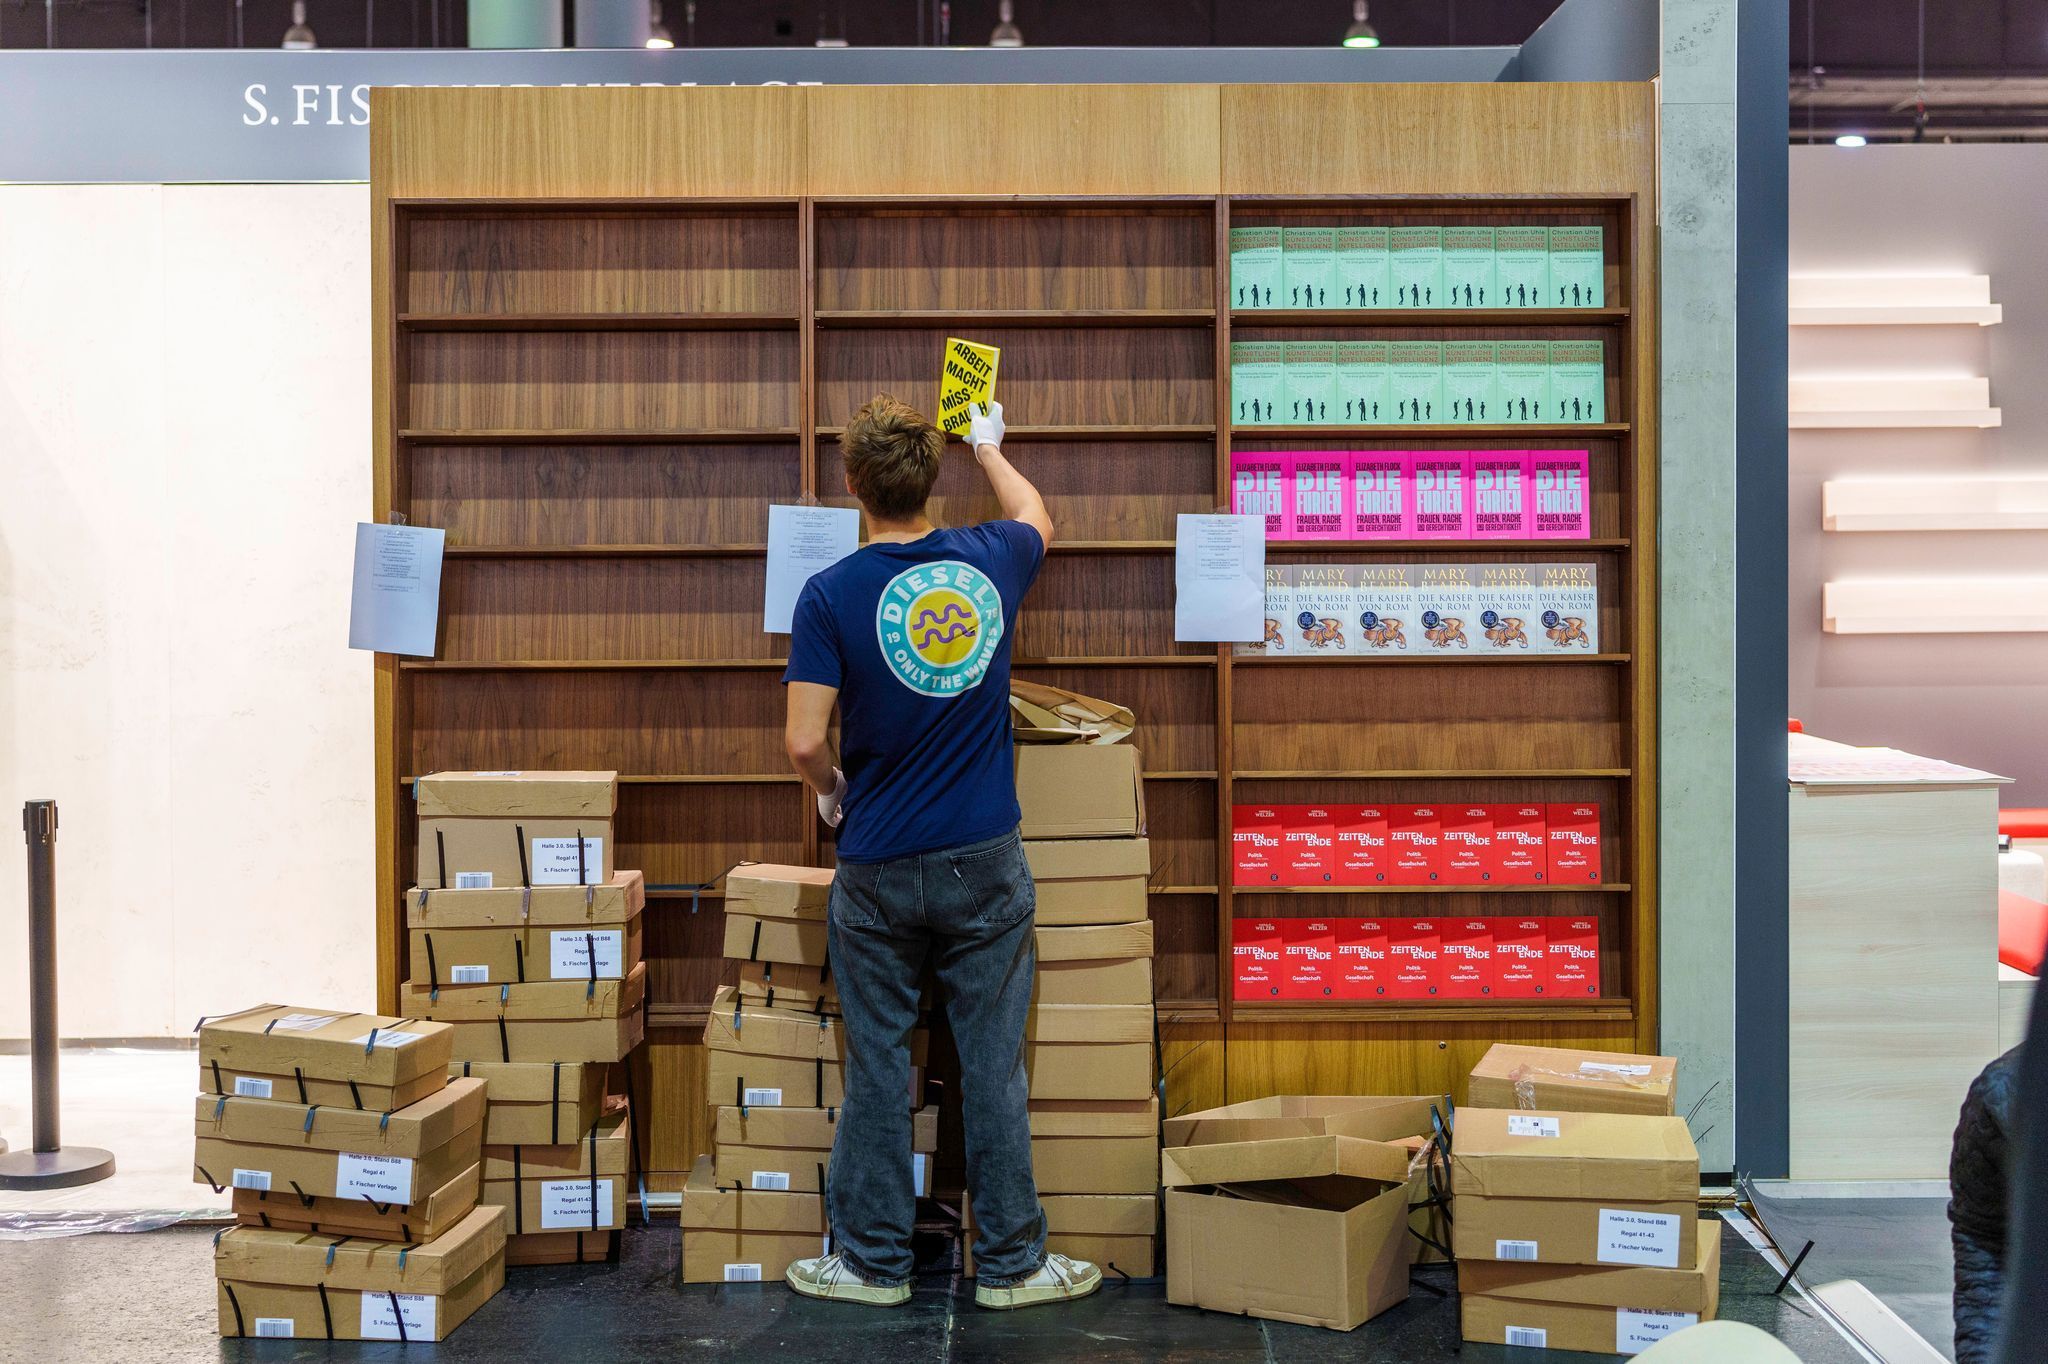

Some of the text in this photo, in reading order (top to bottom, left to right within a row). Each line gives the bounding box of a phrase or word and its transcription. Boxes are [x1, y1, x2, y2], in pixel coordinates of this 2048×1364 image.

[242, 83, 280, 126] S.
[953, 342, 993, 378] ARBEIT
[946, 360, 988, 393] MACHT
[942, 401, 988, 433] BRAUH
[1296, 463, 1341, 471] ELIZABETH FLOCK
[1236, 472, 1282, 491] DIE
[1296, 471, 1341, 491] DIE
[1356, 471, 1401, 490] DIE
[1416, 470, 1461, 490] DIE
[1476, 470, 1521, 490] DIE
[1536, 470, 1581, 490] DIE
[1236, 492, 1282, 515] FURIEN
[1296, 492, 1342, 514] FURIEN
[1356, 491, 1402, 514] FURIEN
[1416, 491, 1462, 514] FURIEN
[1476, 491, 1522, 514] FURIEN
[1536, 491, 1582, 514] FURIEN
[1297, 515, 1341, 524] FRAUEN, RACHE
[1302, 569, 1345, 580] MARY
[1363, 569, 1406, 580] MARY
[1424, 568, 1467, 579] MARY
[1485, 568, 1528, 579] MARY
[1546, 568, 1588, 579] MARY
[1300, 581, 1349, 592] BEARD
[1361, 581, 1410, 592] BEARD
[1422, 580, 1471, 591] BEARD
[1482, 580, 1532, 591] BEARD
[1543, 580, 1592, 591] BEARD
[883, 566, 990, 625] DIESEL
[1318, 594, 1351, 602] KAISER
[1379, 594, 1413, 602] KAISER
[1561, 593, 1595, 601] KAISER
[1299, 603, 1349, 611] VON ROM
[1360, 603, 1410, 611] VON ROM
[1542, 602, 1592, 610] VON ROM
[886, 632, 900, 644] 19
[894, 627, 998, 689] ONLY THE WAVES
[1233, 833, 1265, 841] ZEITEN
[1285, 833, 1317, 841] ZEITEN
[1338, 833, 1370, 841] ZEITEN
[1391, 832, 1423, 840] ZEITEN
[1443, 832, 1475, 840] ZEITEN
[1496, 832, 1528, 840] ZEITEN
[1550, 832, 1582, 840] ZEITEN
[1254, 838, 1279, 846] ENDE
[1306, 838, 1331, 846] ENDE
[1359, 838, 1384, 846] ENDE
[1412, 837, 1437, 845] ENDE
[1464, 837, 1489, 845] ENDE
[1517, 837, 1542, 845] ENDE
[1571, 837, 1596, 845] ENDE
[1233, 947, 1265, 955] ZEITEN
[1285, 947, 1317, 955] ZEITEN
[1338, 946, 1370, 954] ZEITEN
[1390, 946, 1422, 954] ZEITEN
[1443, 946, 1475, 954] ZEITEN
[1496, 945, 1528, 953] ZEITEN
[1548, 945, 1580, 953] ZEITEN
[1254, 952, 1279, 960] ENDE
[1306, 952, 1331, 960] ENDE
[1359, 951, 1384, 959] ENDE
[1411, 951, 1436, 959] ENDE
[1464, 951, 1489, 959] ENDE
[1517, 950, 1542, 958] ENDE
[1569, 950, 1594, 958] ENDE
[377, 1183, 397, 1191] Verlage
